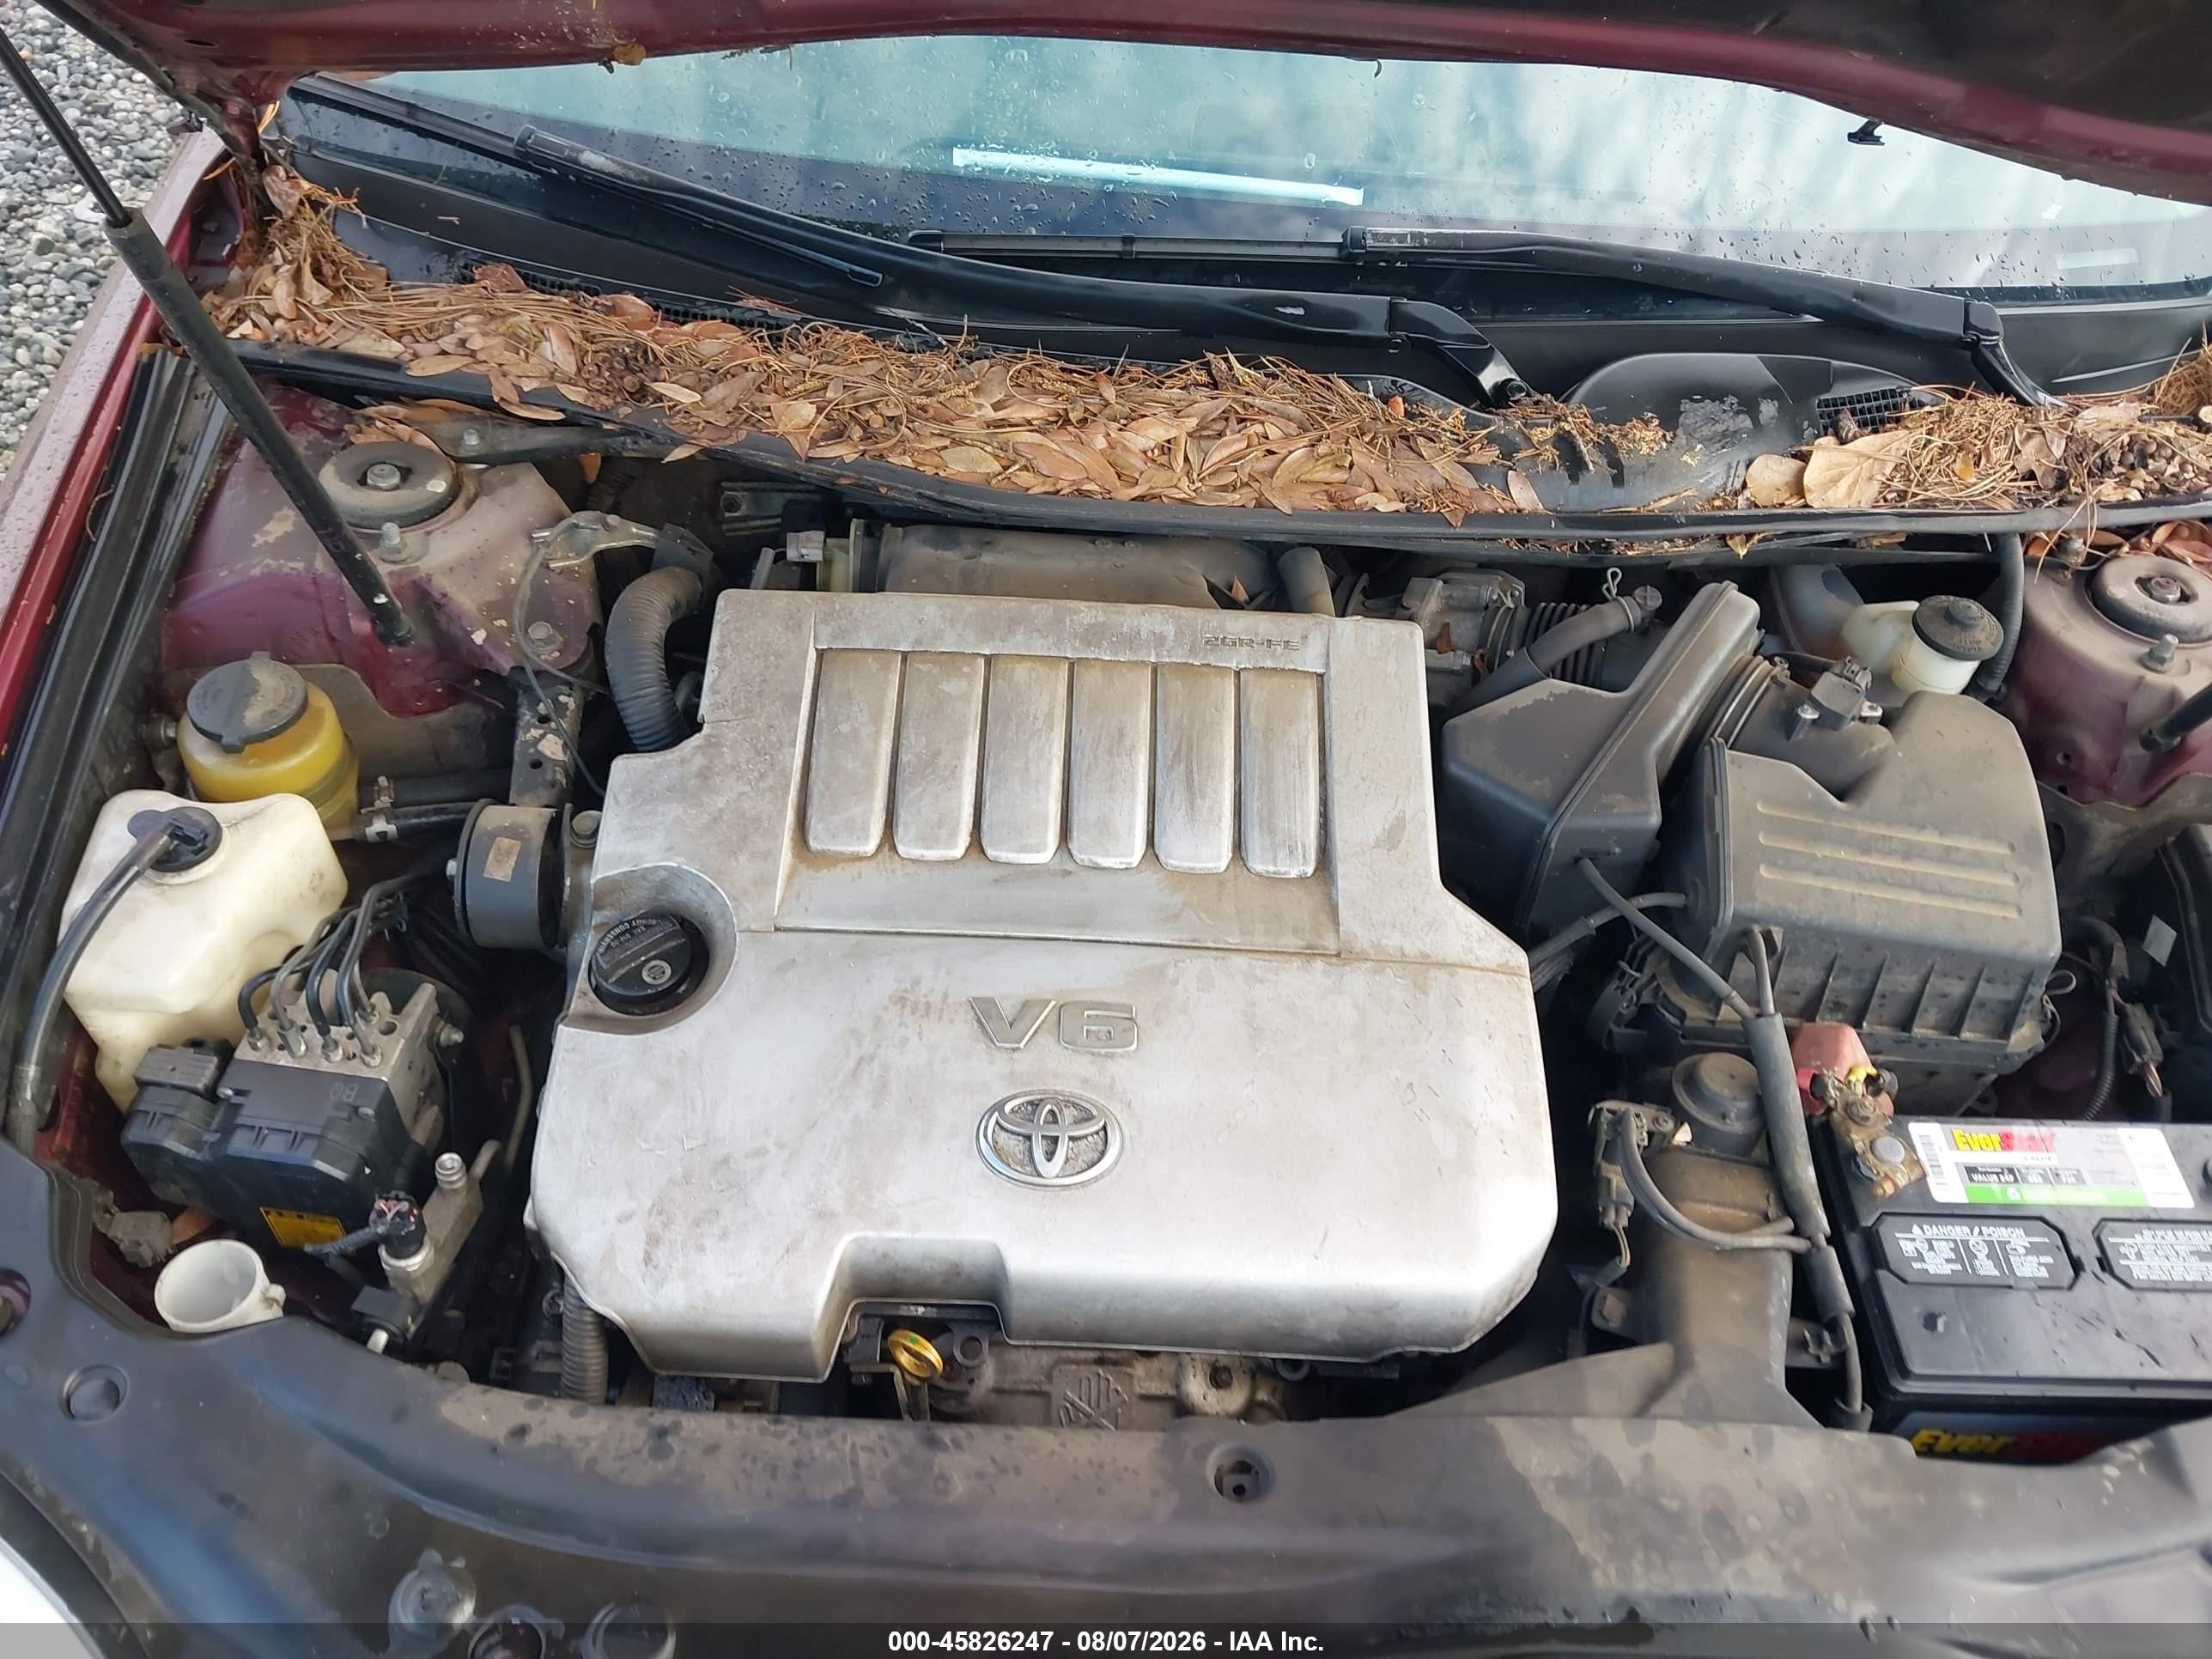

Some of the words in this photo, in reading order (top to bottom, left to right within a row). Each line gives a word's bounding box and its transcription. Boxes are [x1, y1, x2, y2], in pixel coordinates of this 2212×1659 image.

[1202, 634, 1299, 651] 2GR-FE
[969, 997, 1138, 1052] V6
[1923, 1224, 1971, 1237] DANGER
[1982, 1226, 2026, 1238] POISON
